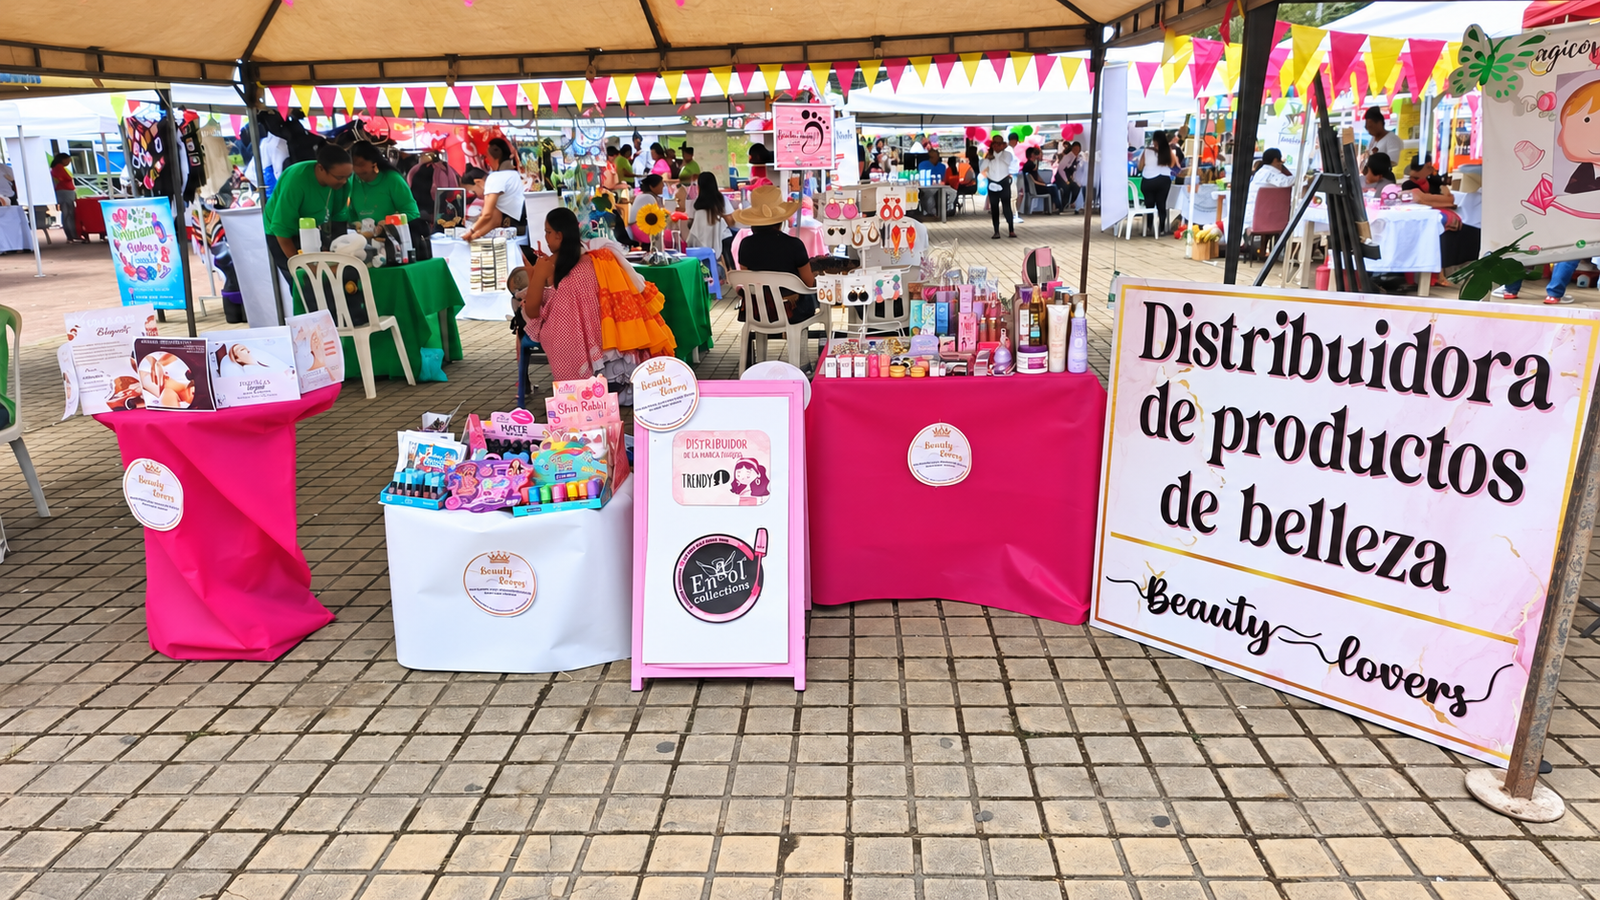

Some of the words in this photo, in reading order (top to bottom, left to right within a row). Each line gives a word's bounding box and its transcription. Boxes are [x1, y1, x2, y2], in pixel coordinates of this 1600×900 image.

[1139, 302, 1554, 411] Distribuidora
[682, 473, 713, 488] TRENDY
[686, 438, 748, 450] DISTRIBUIDOR
[1140, 381, 1196, 443] de
[1207, 406, 1527, 503] productos
[1161, 471, 1218, 534] de
[1240, 484, 1450, 592] belleza
[693, 581, 750, 604] collections
[1108, 576, 1315, 656] Beauty
[1290, 636, 1512, 718] lovers
